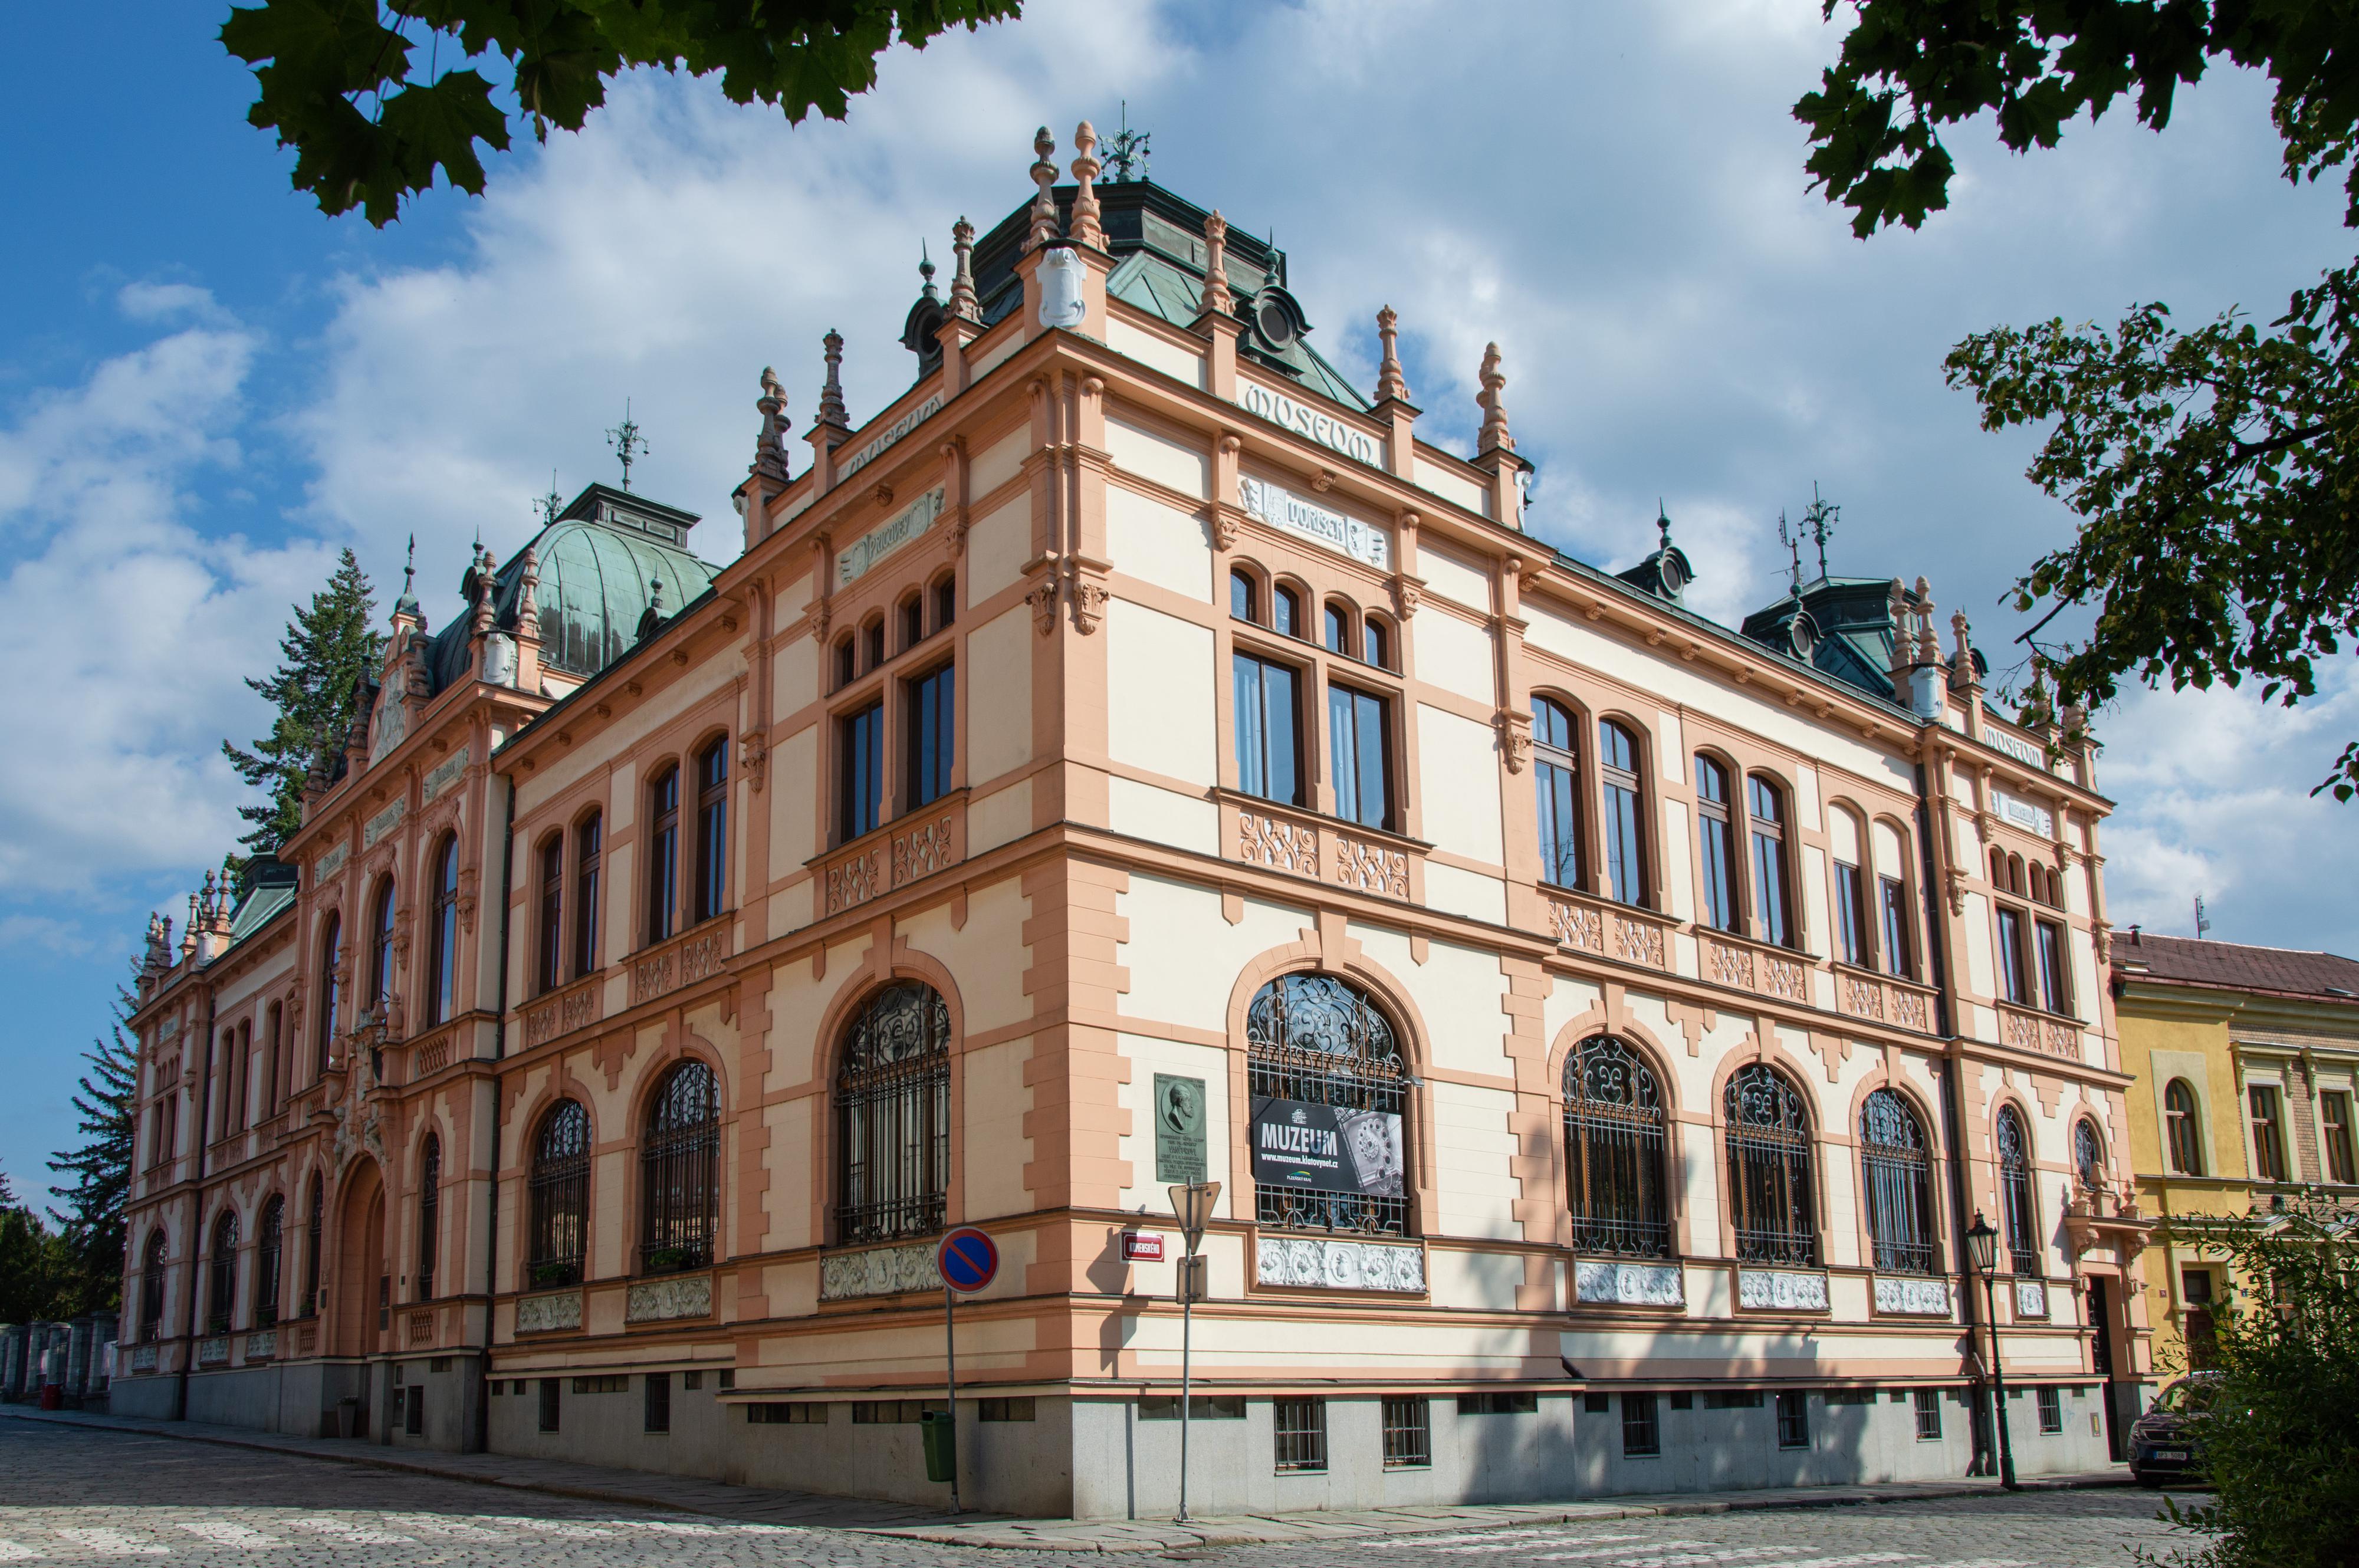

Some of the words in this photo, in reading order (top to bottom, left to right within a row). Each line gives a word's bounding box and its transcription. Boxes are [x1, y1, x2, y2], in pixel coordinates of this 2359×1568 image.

[1245, 384, 1372, 466] MUSEUM
[1261, 1122, 1338, 1156] MUZEUM
[1261, 1153, 1338, 1168] www.muzeum.klatovynet.cz
[1129, 1242, 1160, 1254] KOMENSKÉHO
